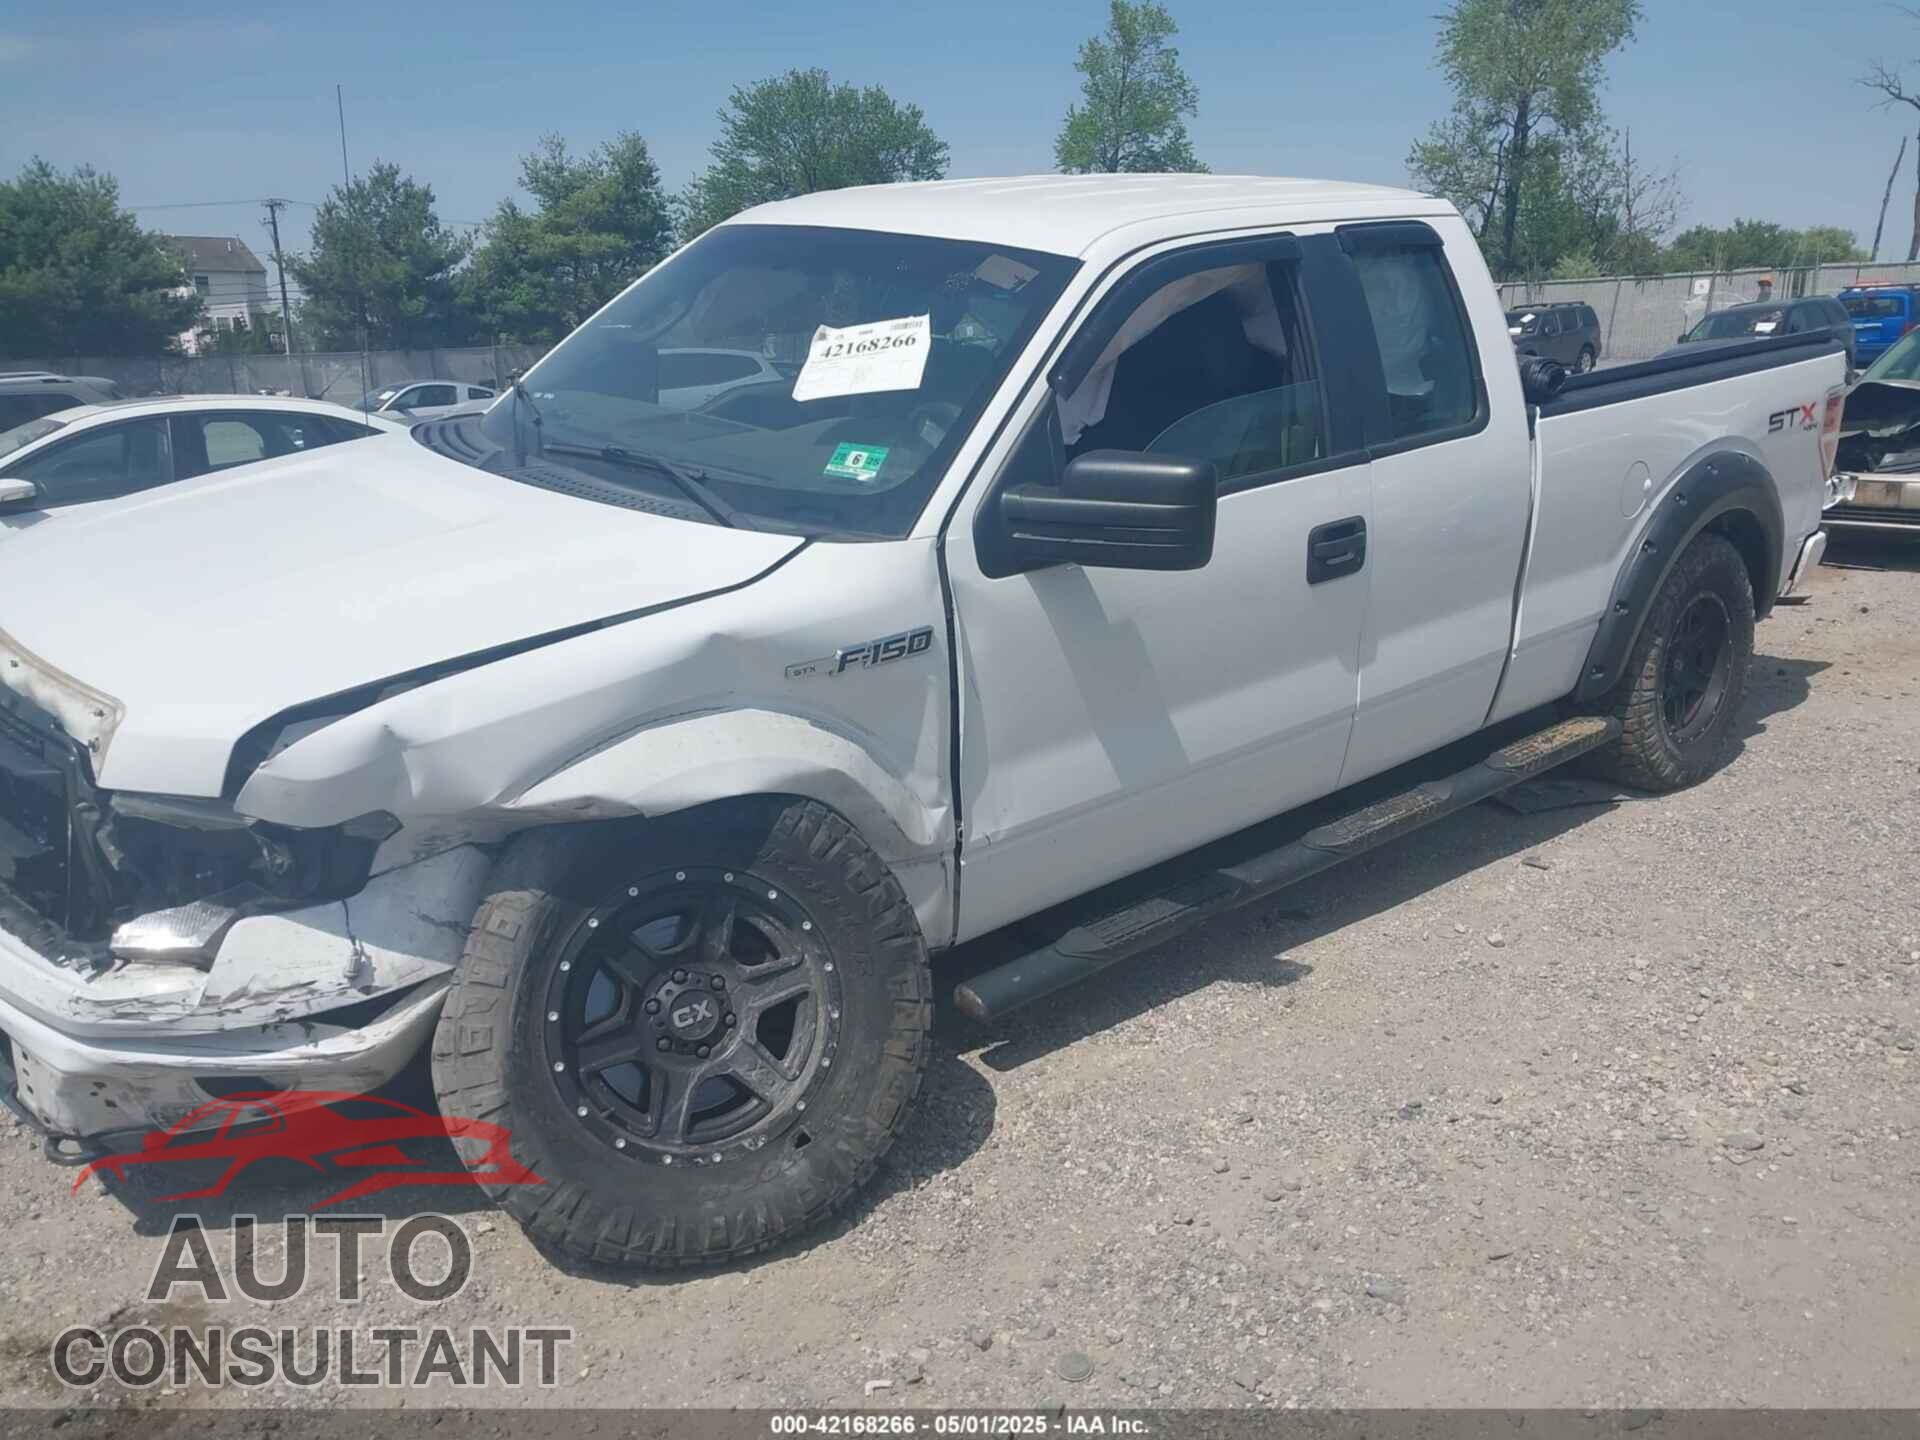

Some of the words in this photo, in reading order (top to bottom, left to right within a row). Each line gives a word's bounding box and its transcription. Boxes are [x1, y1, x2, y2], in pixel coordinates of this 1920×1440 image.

[820, 334, 917, 358] 42168266
[1768, 401, 1816, 435] STX
[852, 454, 862, 466] 6
[836, 626, 933, 672] F-150
